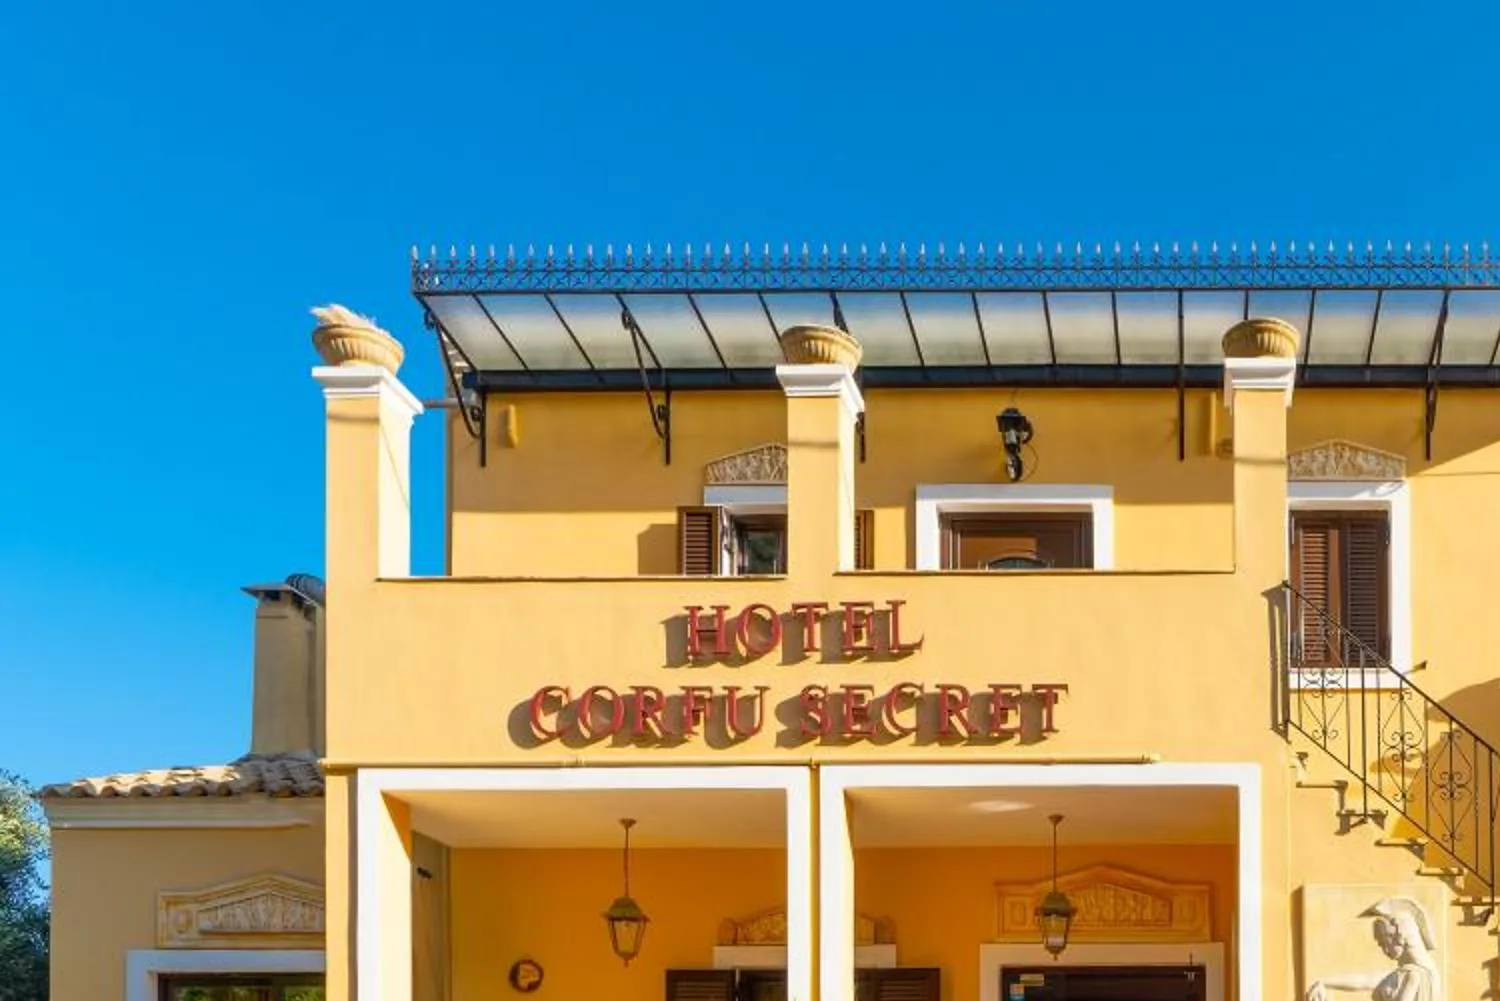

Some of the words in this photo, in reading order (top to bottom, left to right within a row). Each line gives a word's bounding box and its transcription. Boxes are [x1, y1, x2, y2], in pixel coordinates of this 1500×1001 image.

[684, 600, 924, 657] HOTEL
[529, 684, 771, 742] CORFU
[799, 682, 1069, 738] SECRET
